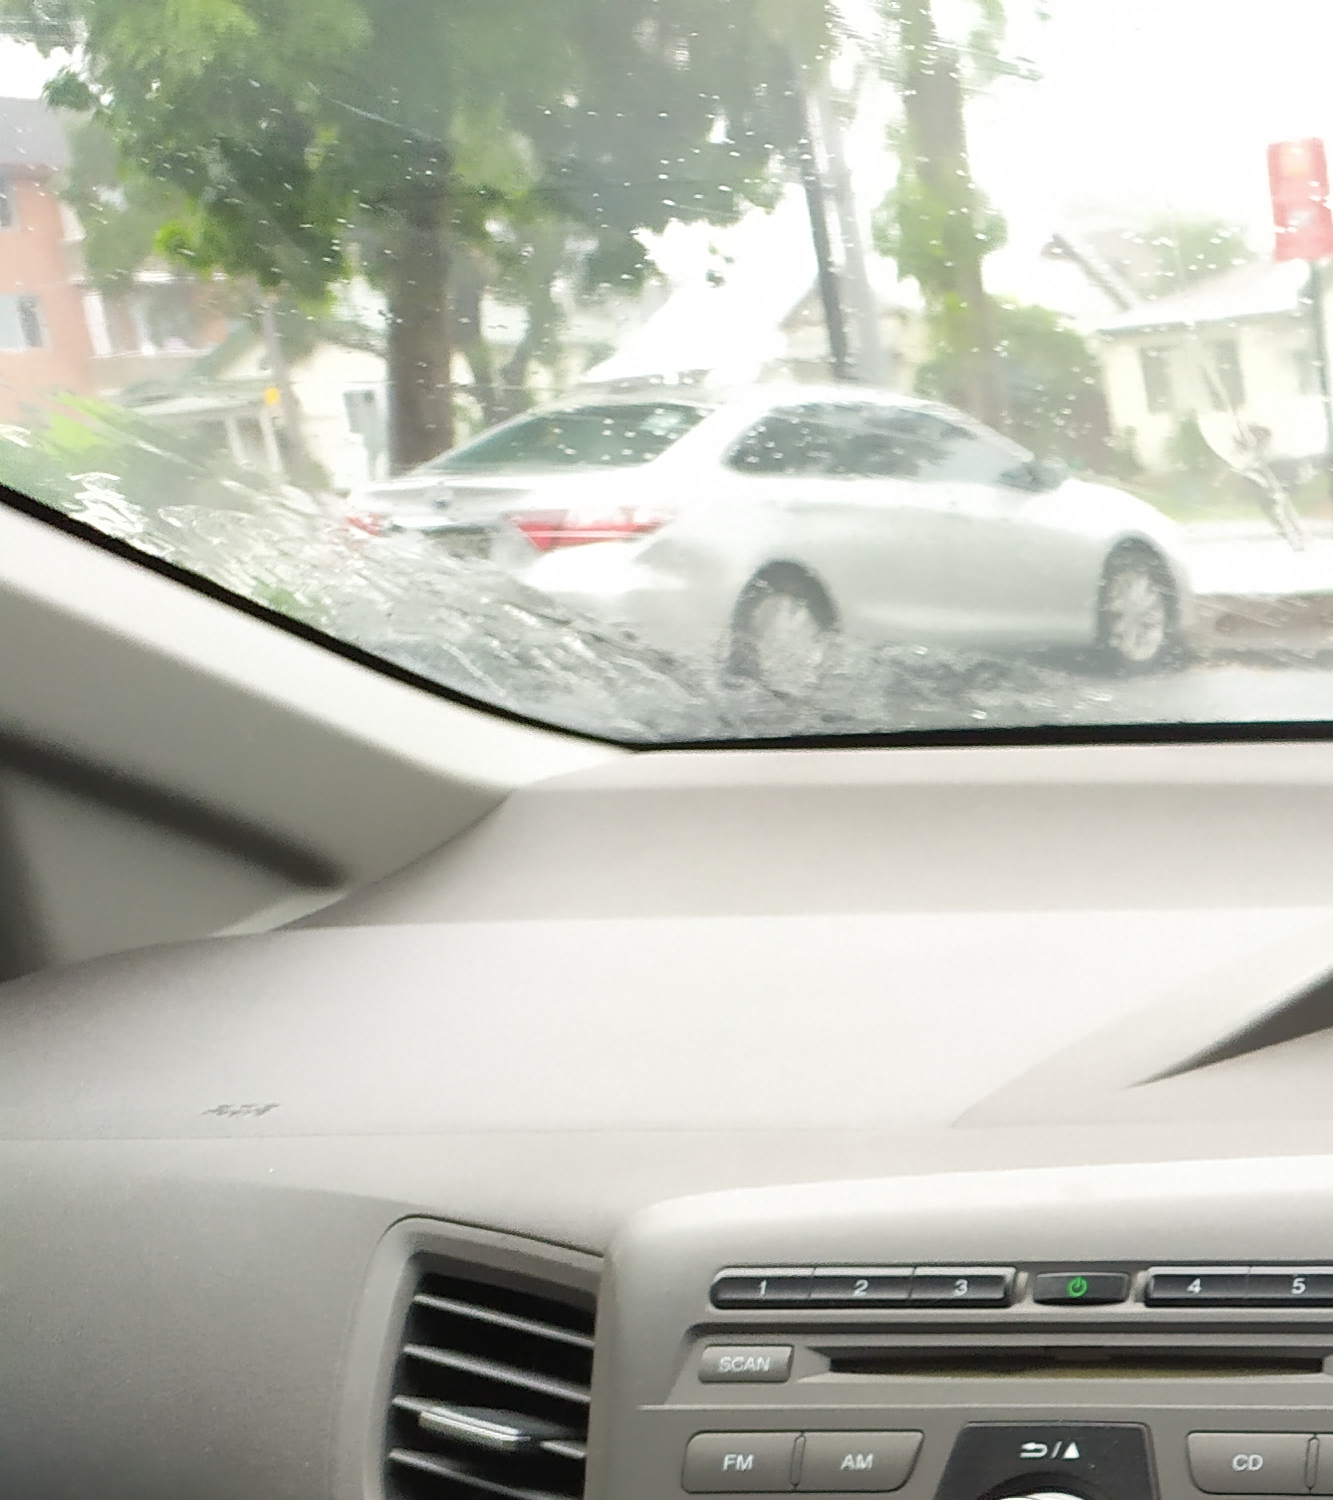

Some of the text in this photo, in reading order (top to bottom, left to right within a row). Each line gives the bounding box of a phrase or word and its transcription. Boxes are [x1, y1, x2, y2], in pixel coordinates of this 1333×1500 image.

[757, 1279, 968, 1297] 1 2 3
[1186, 1278, 1202, 1294] 4
[1291, 1277, 1306, 1294] 5
[719, 1356, 771, 1372] SCAN
[723, 1454, 873, 1471] FM AM
[1231, 1454, 1263, 1472] CD
